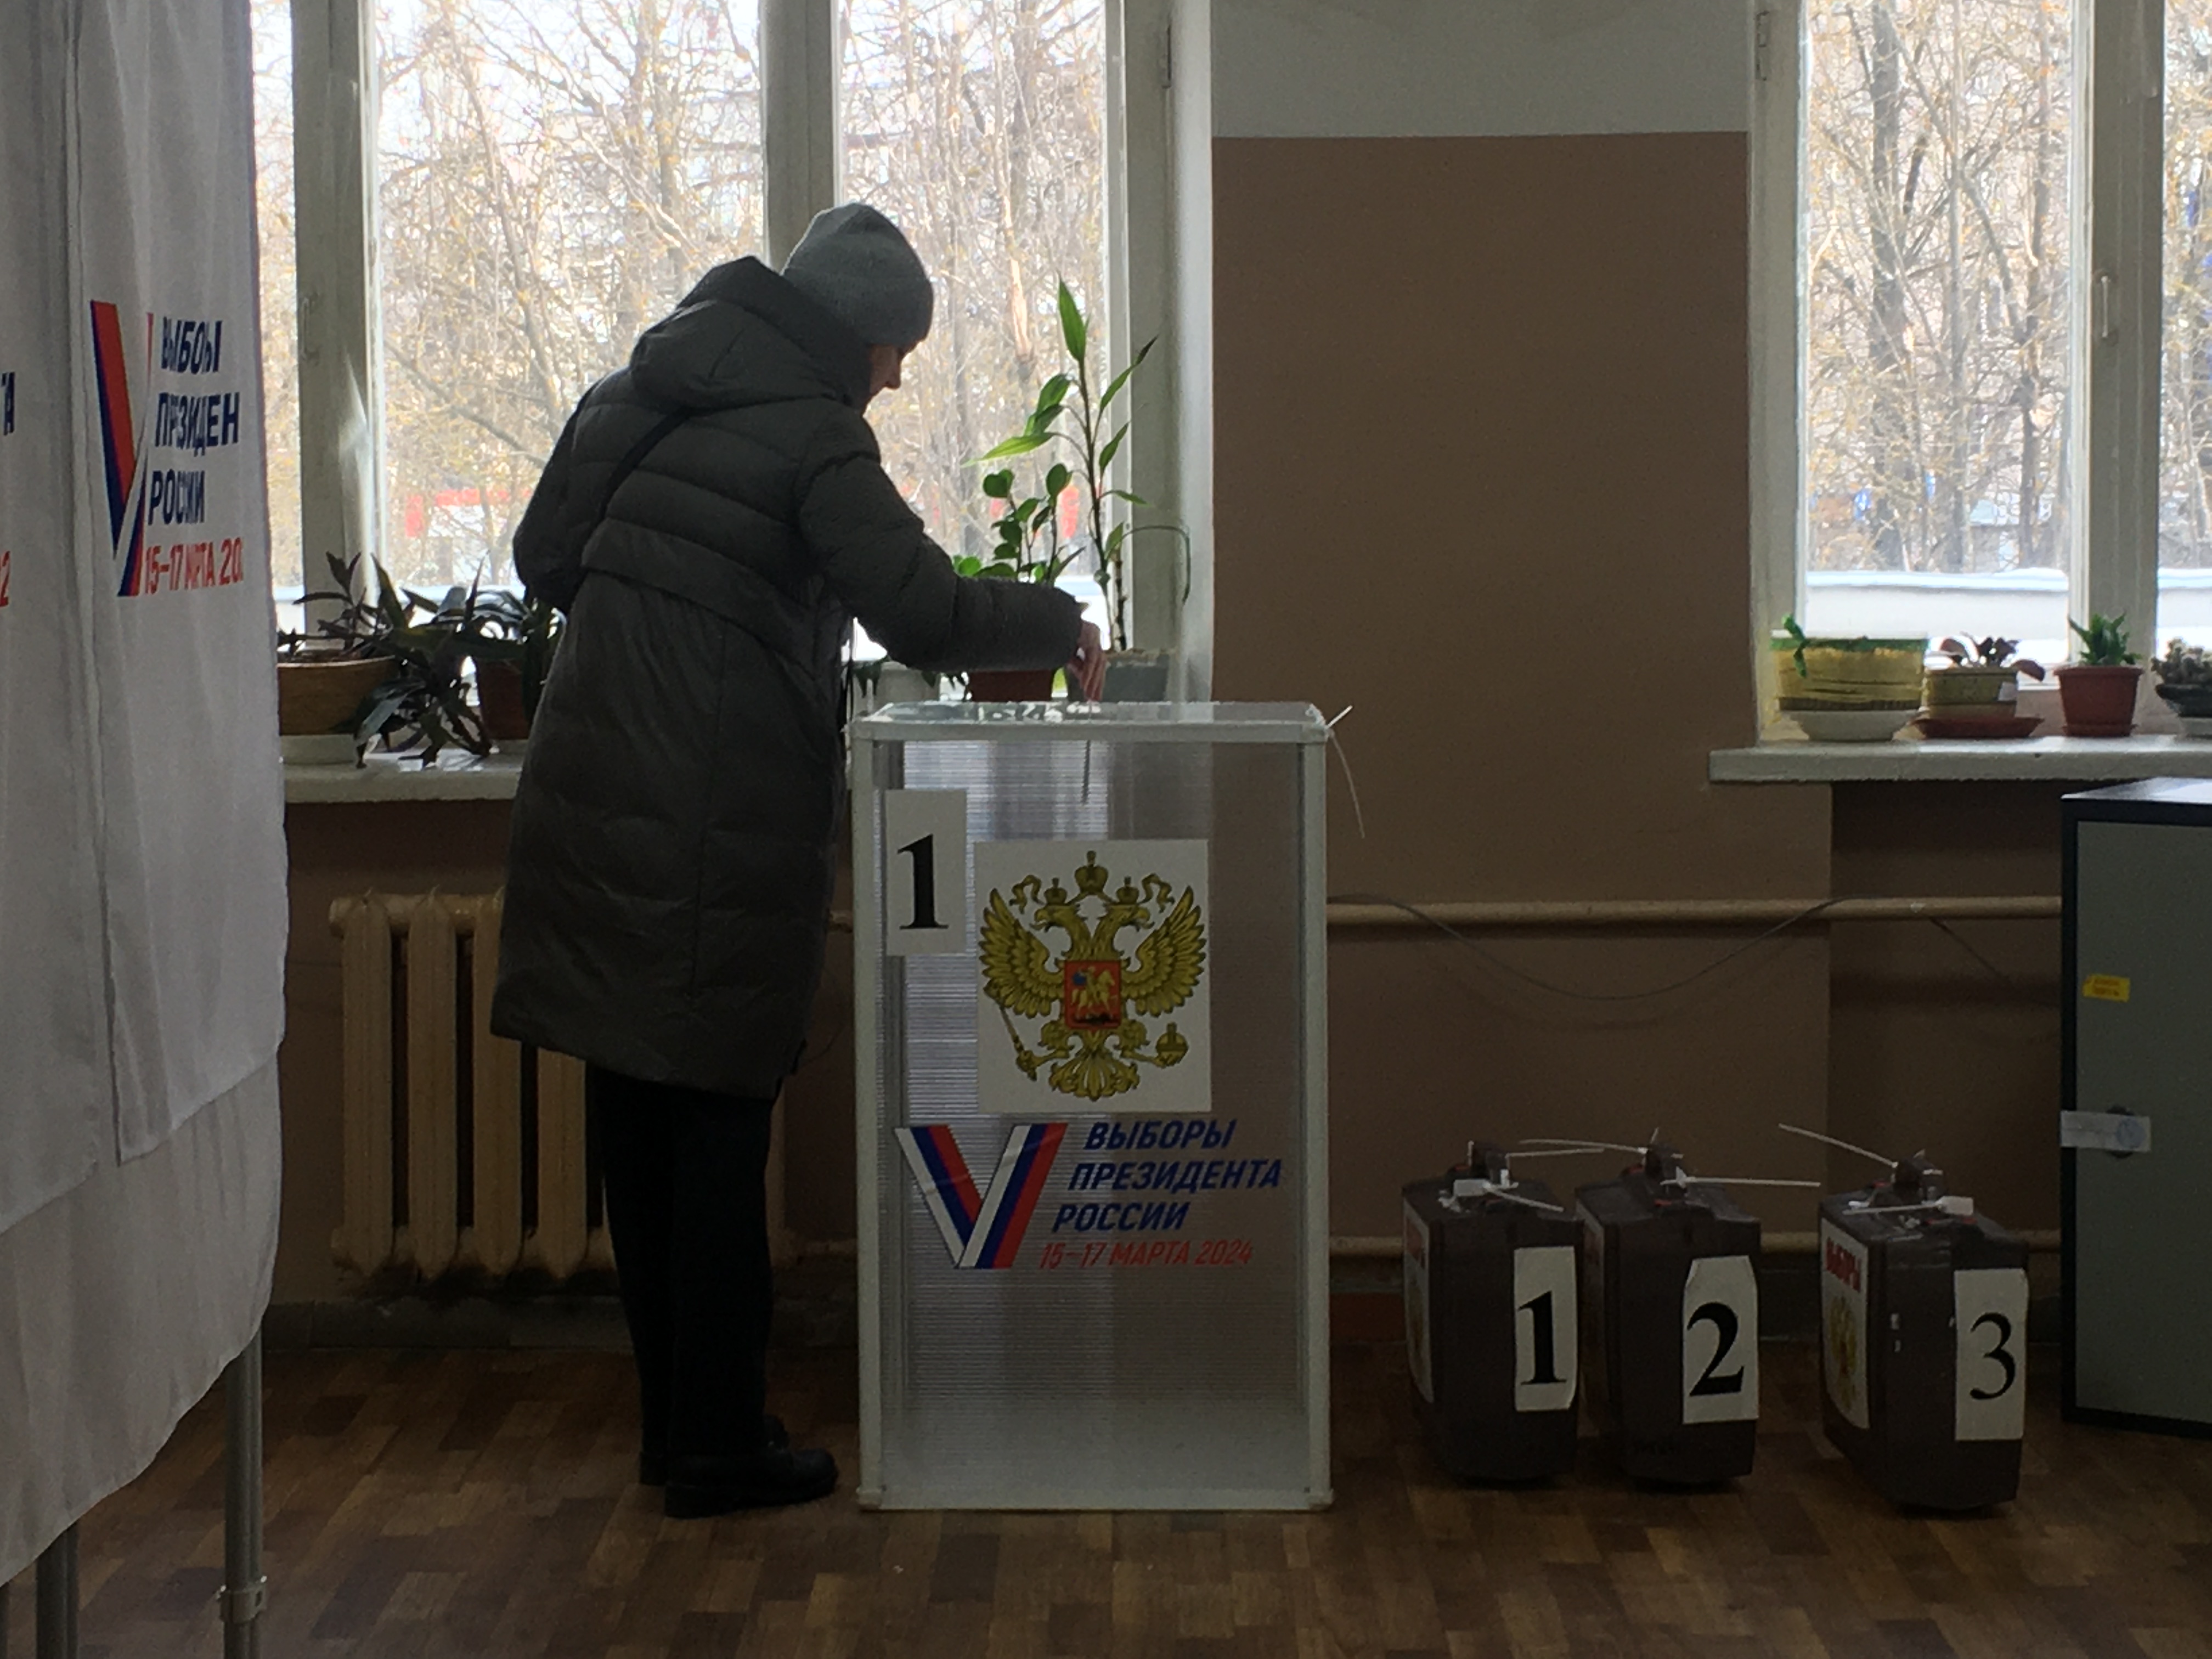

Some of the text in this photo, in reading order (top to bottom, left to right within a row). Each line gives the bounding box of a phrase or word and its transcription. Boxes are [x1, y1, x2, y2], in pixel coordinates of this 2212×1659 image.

[161, 316, 223, 374] ВЫБОЫ
[897, 834, 950, 930] 1
[1085, 1120, 1235, 1150] ВЫБОРЫ
[1068, 1159, 1281, 1193] ПРЕЗИДЕНТА
[1052, 1201, 1190, 1234] РОССИИ
[1108, 1241, 1190, 1267] МАРТА
[1194, 1239, 1253, 1266] 2024
[1517, 1290, 1567, 1386] 1
[1686, 1301, 1745, 1397] 2
[1970, 1312, 2017, 1401] 3
